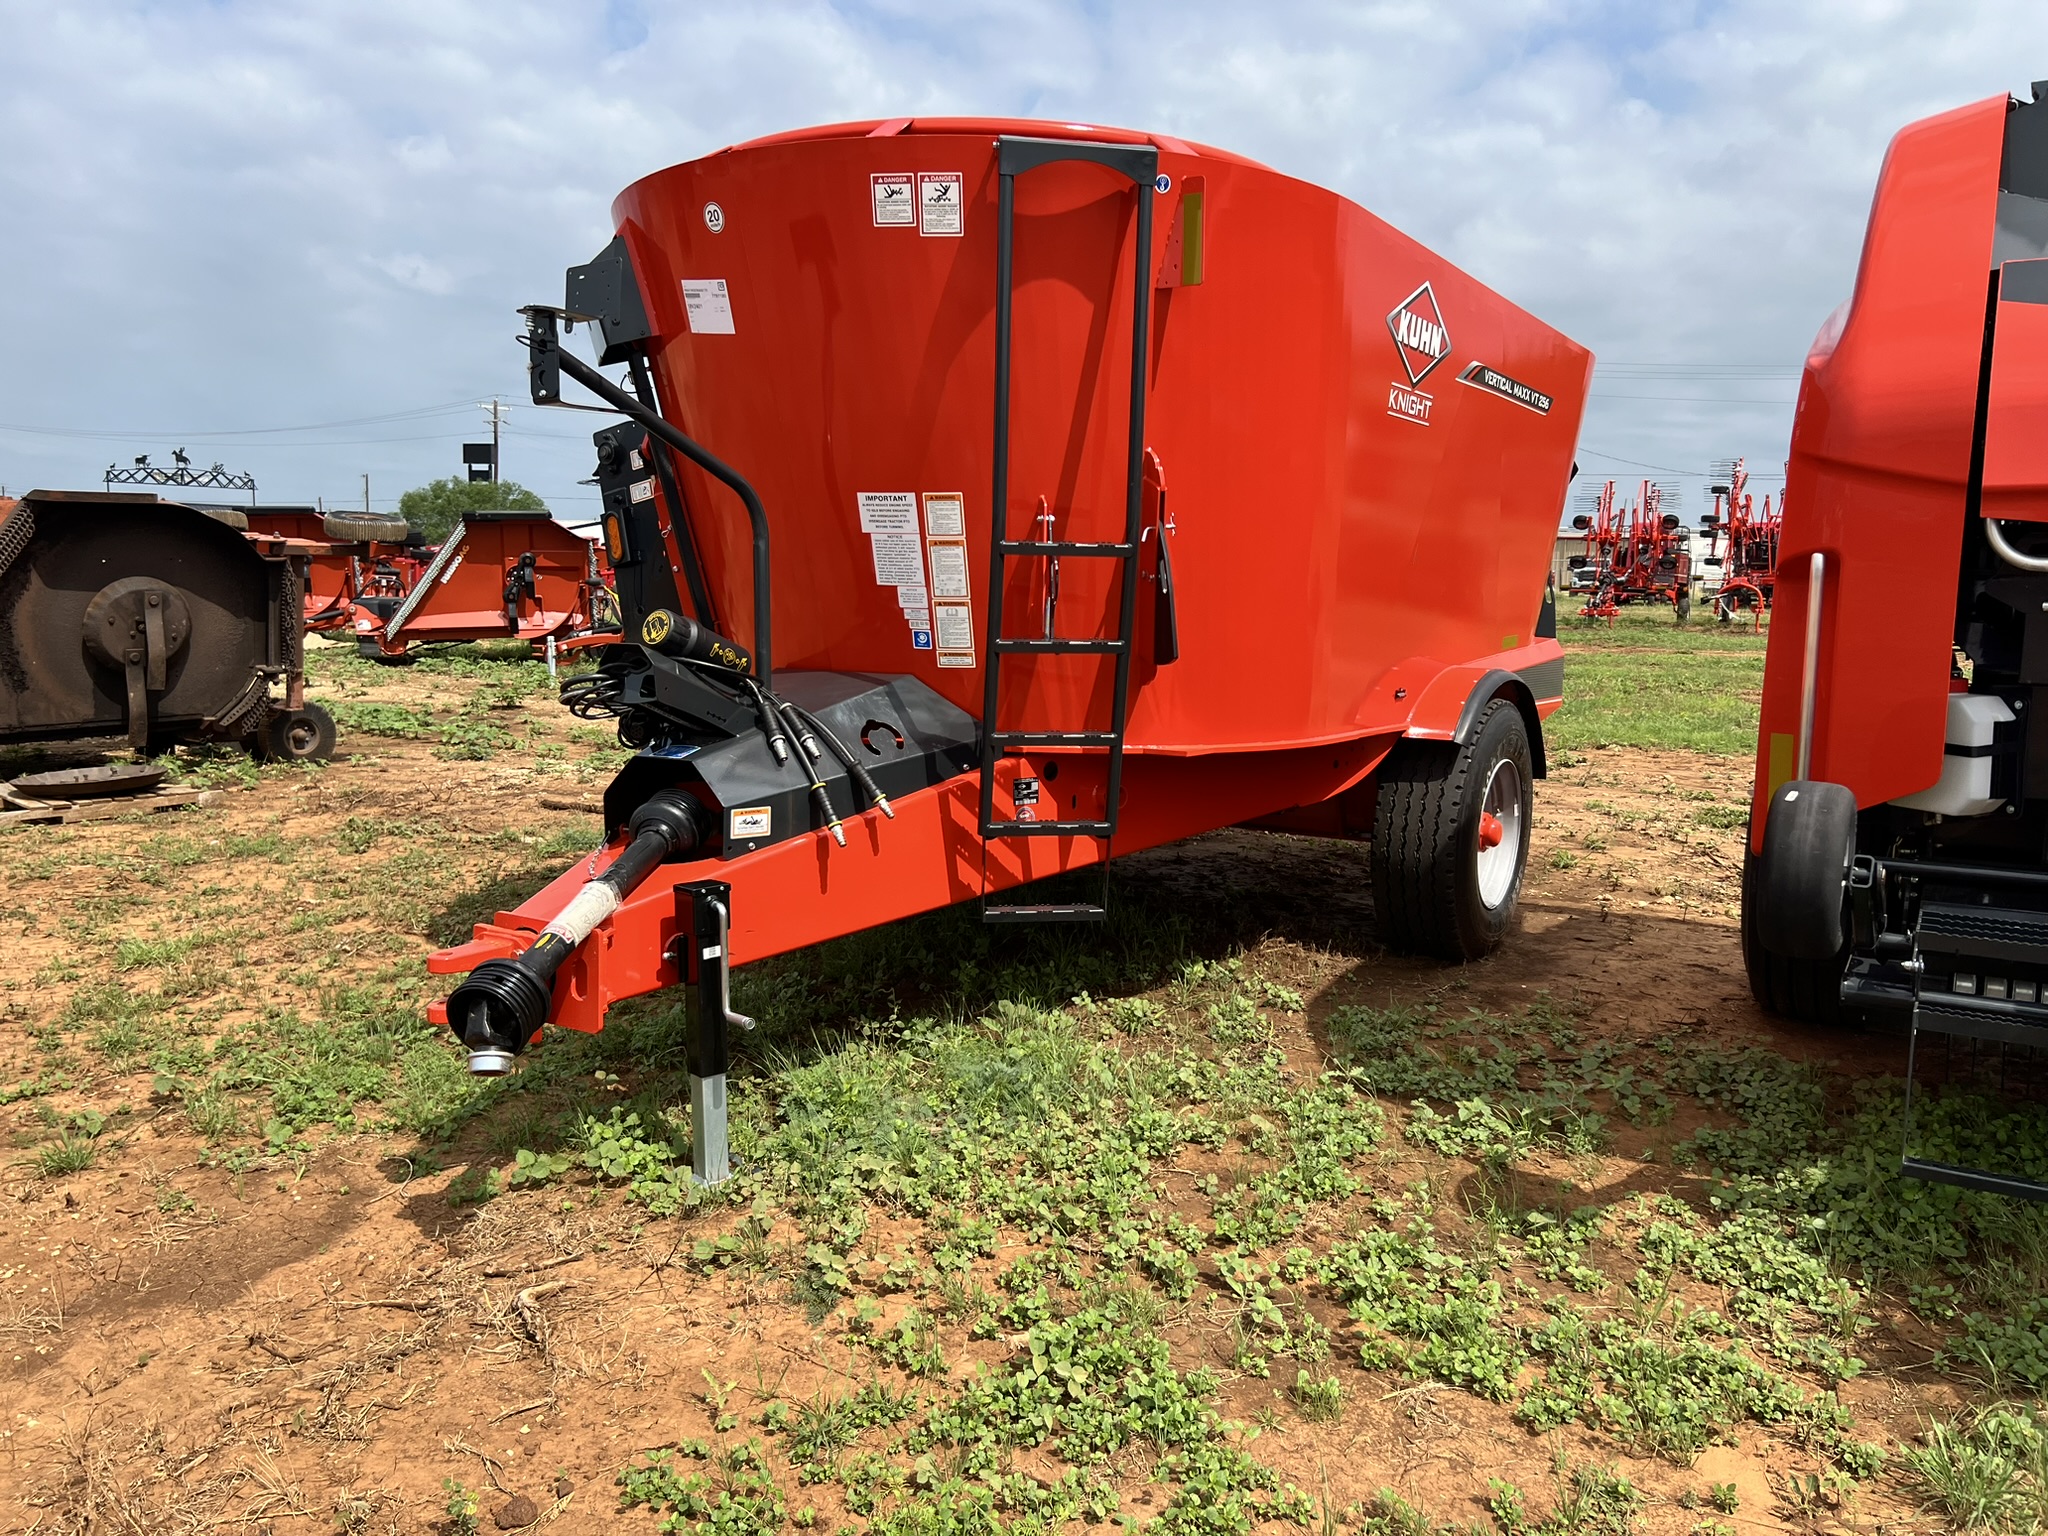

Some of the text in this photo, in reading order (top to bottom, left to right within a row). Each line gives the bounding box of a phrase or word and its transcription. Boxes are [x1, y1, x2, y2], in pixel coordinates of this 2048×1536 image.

[707, 209, 720, 223] 20
[1397, 308, 1443, 359] KUHN
[1388, 389, 1432, 419] KNIGHT
[1484, 369, 1550, 410] VERTICAL MAXX VT 256
